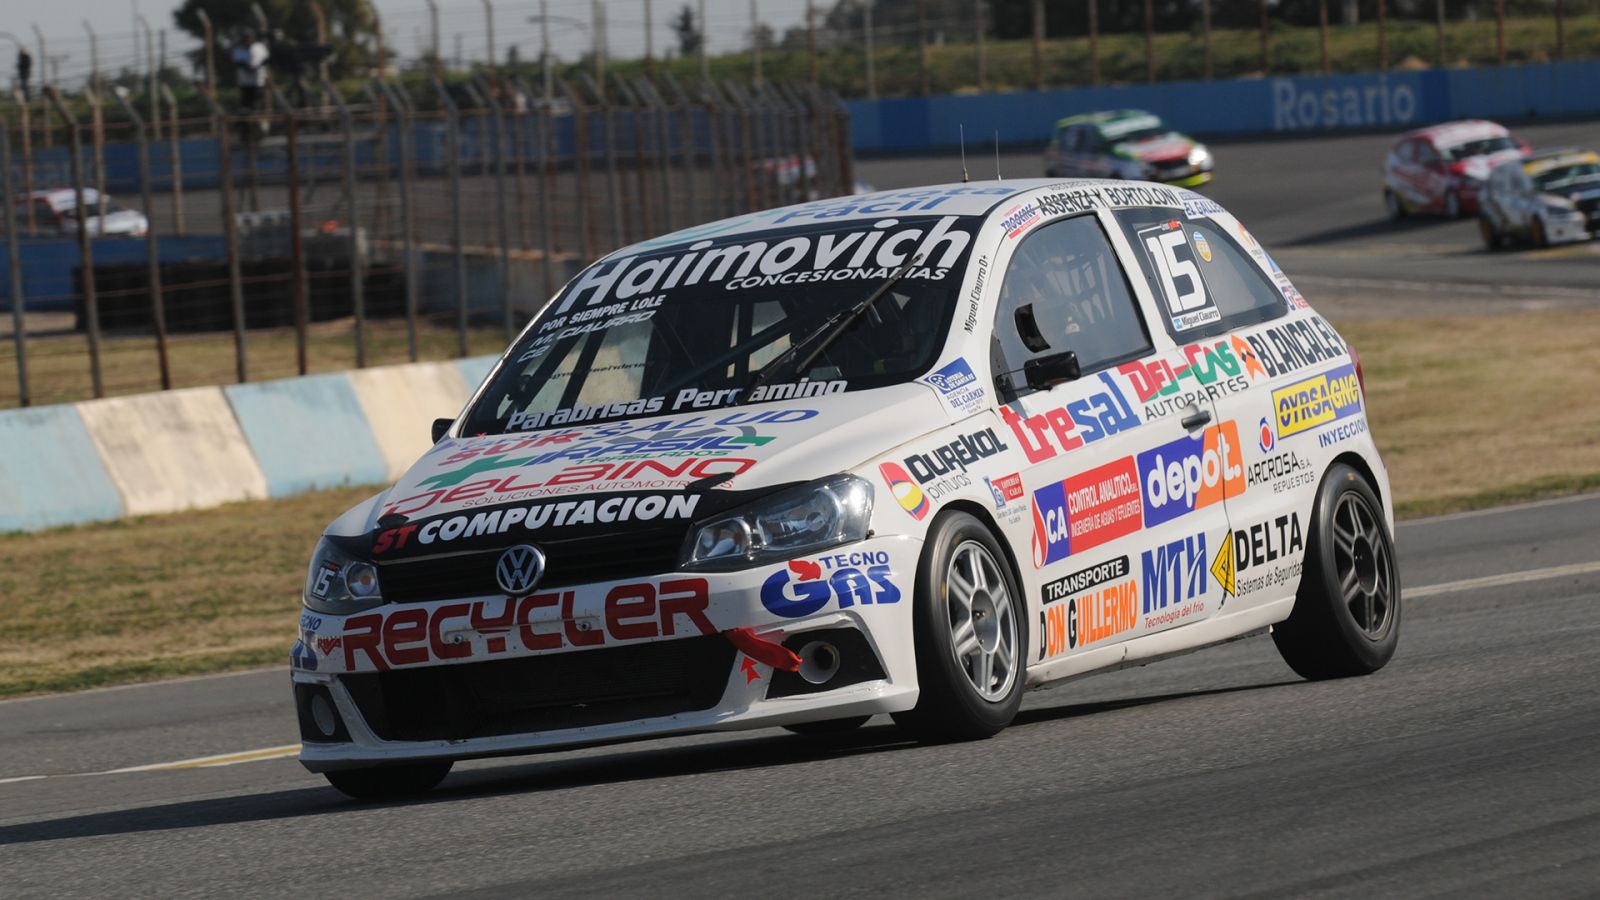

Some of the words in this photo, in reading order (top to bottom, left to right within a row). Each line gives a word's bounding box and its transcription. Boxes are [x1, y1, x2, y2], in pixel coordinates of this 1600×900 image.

[1273, 74, 1416, 132] Rosario
[1036, 189, 1098, 216] ASSENZA
[1103, 187, 1182, 206] BORTOLONI
[555, 216, 971, 314] Haimovich
[1146, 230, 1206, 314] 15
[971, 267, 986, 301] Ciaurro
[538, 316, 568, 334] POR
[569, 302, 628, 324] SIEMPRE
[630, 295, 666, 311] LOLE
[556, 310, 657, 340] CIAURRO
[964, 300, 979, 334] Miguel
[1181, 314, 1200, 326] Miguel
[1199, 310, 1219, 322] Ciaurro
[505, 396, 666, 431] Parabrisas
[950, 397, 963, 409] DEL
[961, 388, 985, 404] CARMEN
[1144, 376, 1249, 421] AUTOPARTES
[999, 371, 1142, 464] tresal
[437, 433, 584, 466] SUR
[581, 409, 819, 441] SALUD
[575, 451, 731, 465] TRASLADOS
[904, 427, 1008, 485] DUREKOL
[1247, 451, 1301, 488] ARCROSA
[461, 485, 580, 508] SOLUCIONES
[926, 472, 971, 502] pinturas
[1273, 471, 1315, 493] REPUESTOS
[1068, 485, 1099, 515] CONTROL
[1093, 513, 1101, 529] DE
[1101, 508, 1115, 527] AGUAS
[1113, 506, 1119, 521] Y
[1117, 499, 1140, 520] EFLUENTES
[372, 525, 417, 552] ST
[418, 495, 701, 545] COMPUTACION
[1046, 506, 1068, 544] CA
[1234, 511, 1302, 572] DELTA
[819, 551, 889, 569] TECNO
[1141, 531, 1208, 615] MTH
[312, 567, 336, 597] 15
[760, 565, 901, 618] GAS
[1046, 559, 1124, 601] TRANSPORTE
[1236, 575, 1265, 597] Sistemas
[1264, 569, 1273, 587] de
[1039, 603, 1065, 661] DON
[1068, 579, 1138, 649] GUILLERMO
[1180, 604, 1193, 618] del
